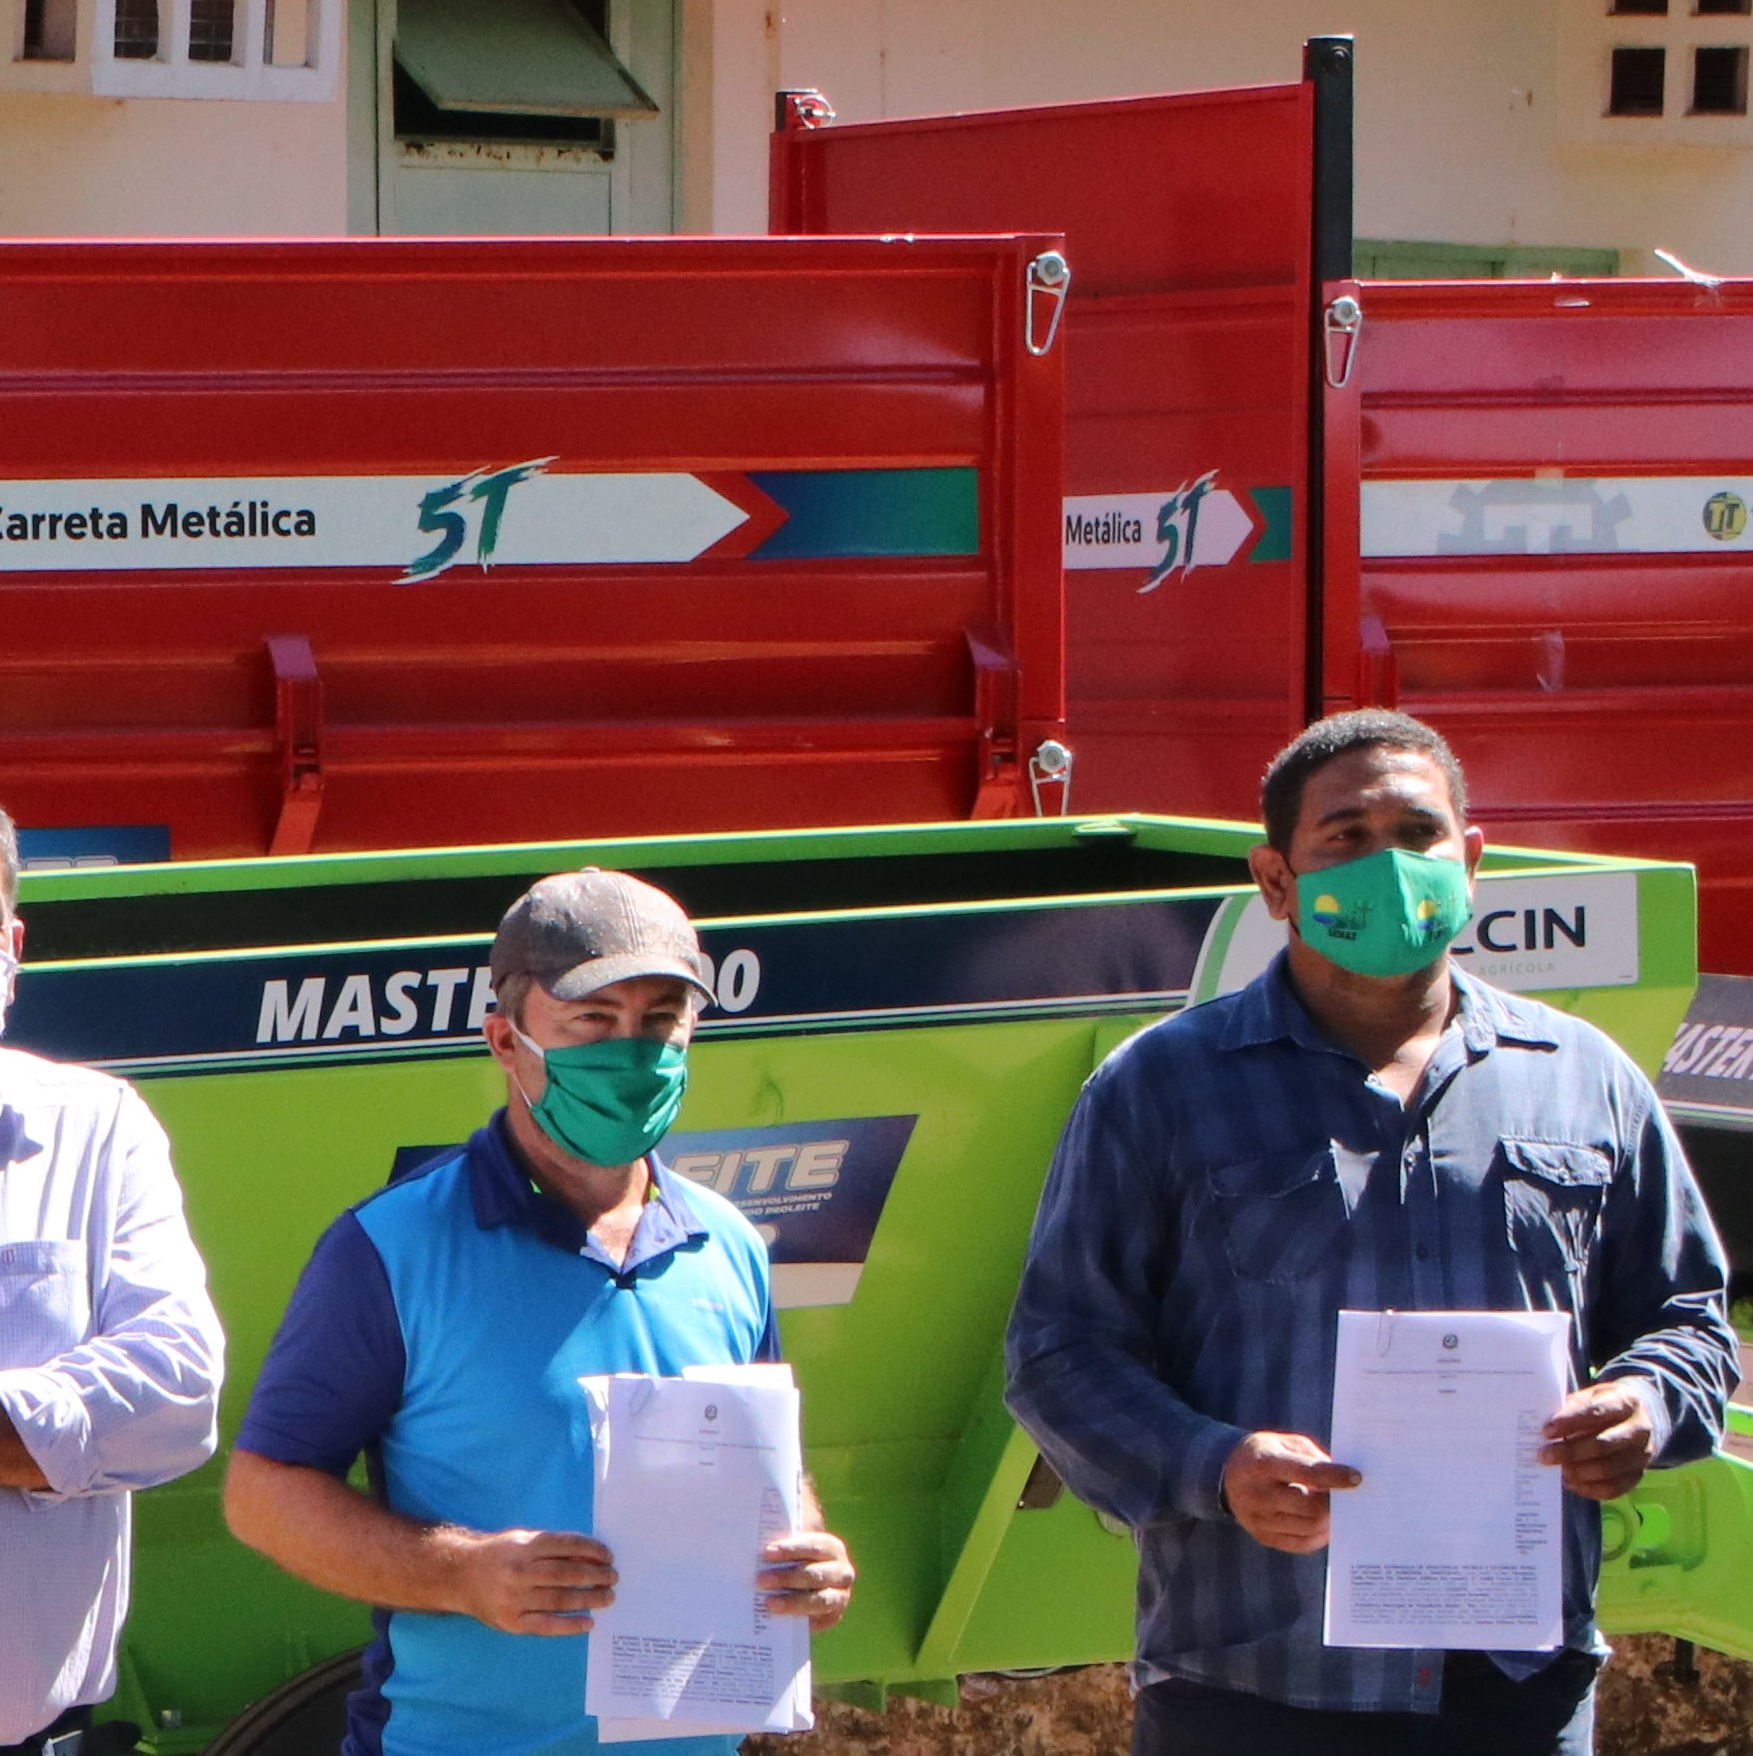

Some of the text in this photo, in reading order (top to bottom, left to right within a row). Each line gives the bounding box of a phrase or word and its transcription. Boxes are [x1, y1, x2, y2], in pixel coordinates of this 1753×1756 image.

[140, 500, 317, 539] Metálica
[1064, 510, 1142, 547] Metálica
[1479, 961, 1555, 976] AGRÍCOLA
[256, 966, 496, 1044] MASTE
[670, 1140, 849, 1195] EITE
